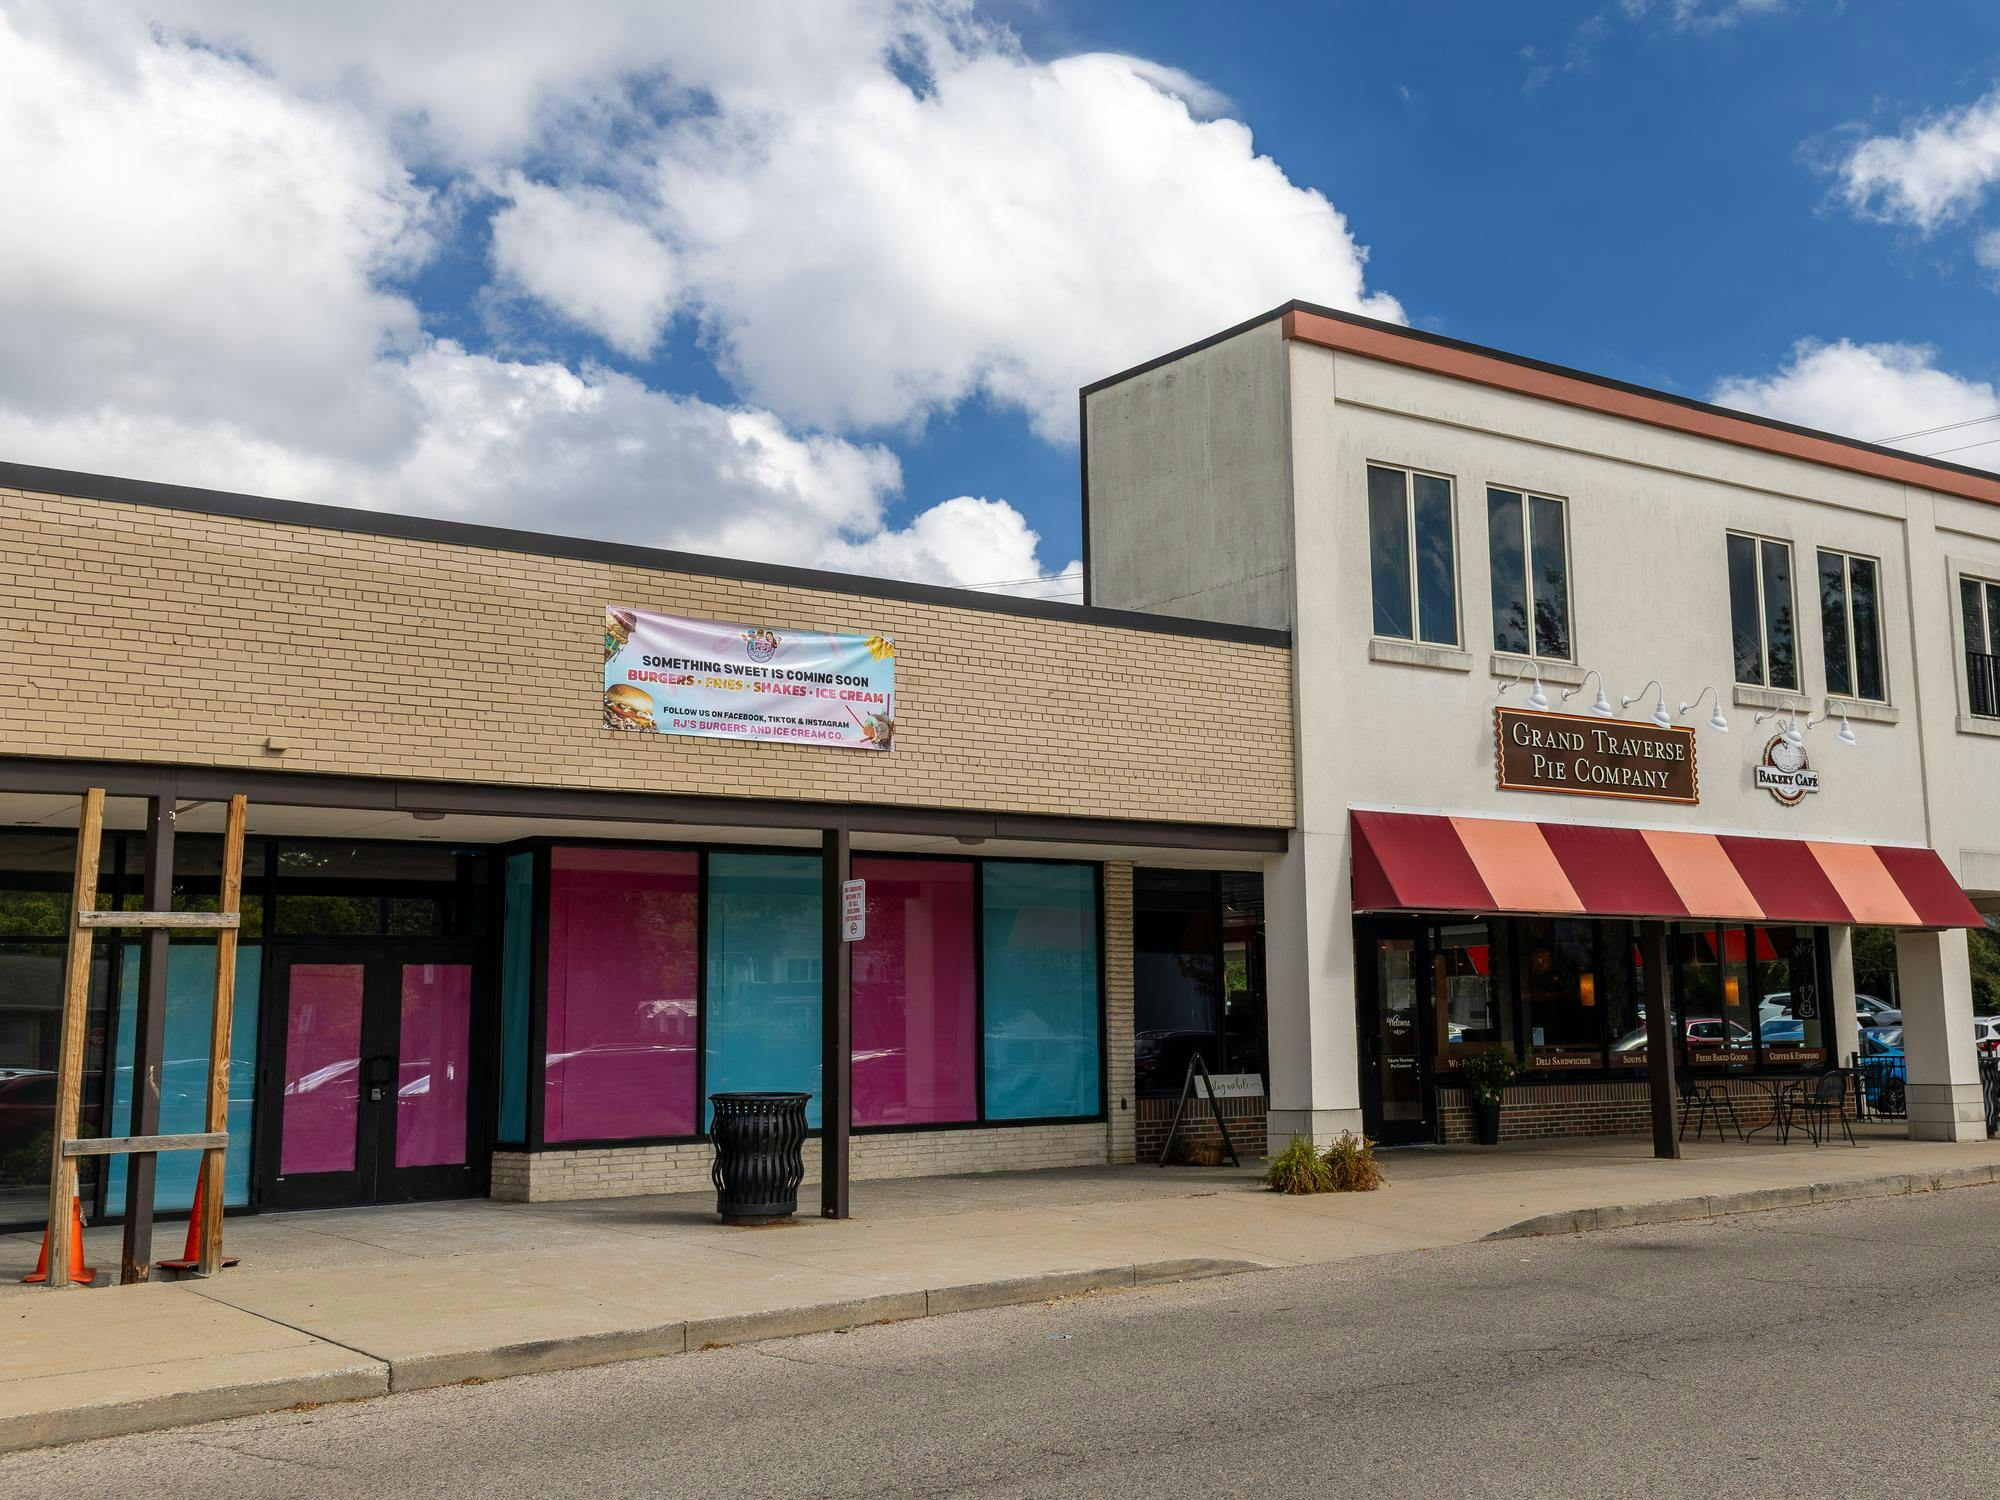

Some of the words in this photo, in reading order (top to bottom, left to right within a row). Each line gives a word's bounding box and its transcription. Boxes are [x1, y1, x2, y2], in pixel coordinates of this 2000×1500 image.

[642, 655, 721, 673] SOMETHING
[723, 664, 768, 678] SWEET
[771, 668, 784, 679] IS
[786, 670, 833, 685] COMING
[835, 675, 869, 687] SOON
[627, 669, 695, 686] BURGERS
[705, 676, 743, 691] FRIES
[753, 681, 807, 697] SHAKES
[815, 687, 836, 699] ICE
[839, 689, 884, 704] CREAM
[663, 706, 698, 716] FOLLOW
[699, 709, 710, 717] US
[724, 712, 766, 723] FACEBOOK,
[768, 715, 796, 724] TIKTOK
[805, 718, 850, 729] INSTAGRAM
[673, 719, 697, 729] RJ'S
[699, 721, 747, 733] BURGERS
[750, 725, 771, 735] AND
[773, 727, 789, 736] ICE
[791, 728, 826, 739] CREAM
[827, 731, 844, 741] CO.
[1512, 722, 1584, 751] GRAND
[1591, 729, 1685, 761] TRAVERSE
[1532, 753, 1566, 780] PIE
[1574, 757, 1670, 789] COMPANY
[1758, 769, 1794, 785] BAKERY
[1535, 1057, 1551, 1066] DELI
[1552, 1056, 1591, 1065] SANDWICHES
[1623, 1055, 1642, 1064] SOUPS
[1695, 1053, 1712, 1062] FRESH
[1730, 1052, 1749, 1061] GOODS
[1769, 1052, 1789, 1060] COFFEE
[1789, 1051, 1795, 1060] &
[1795, 1052, 1820, 1060] ESPRESSO
